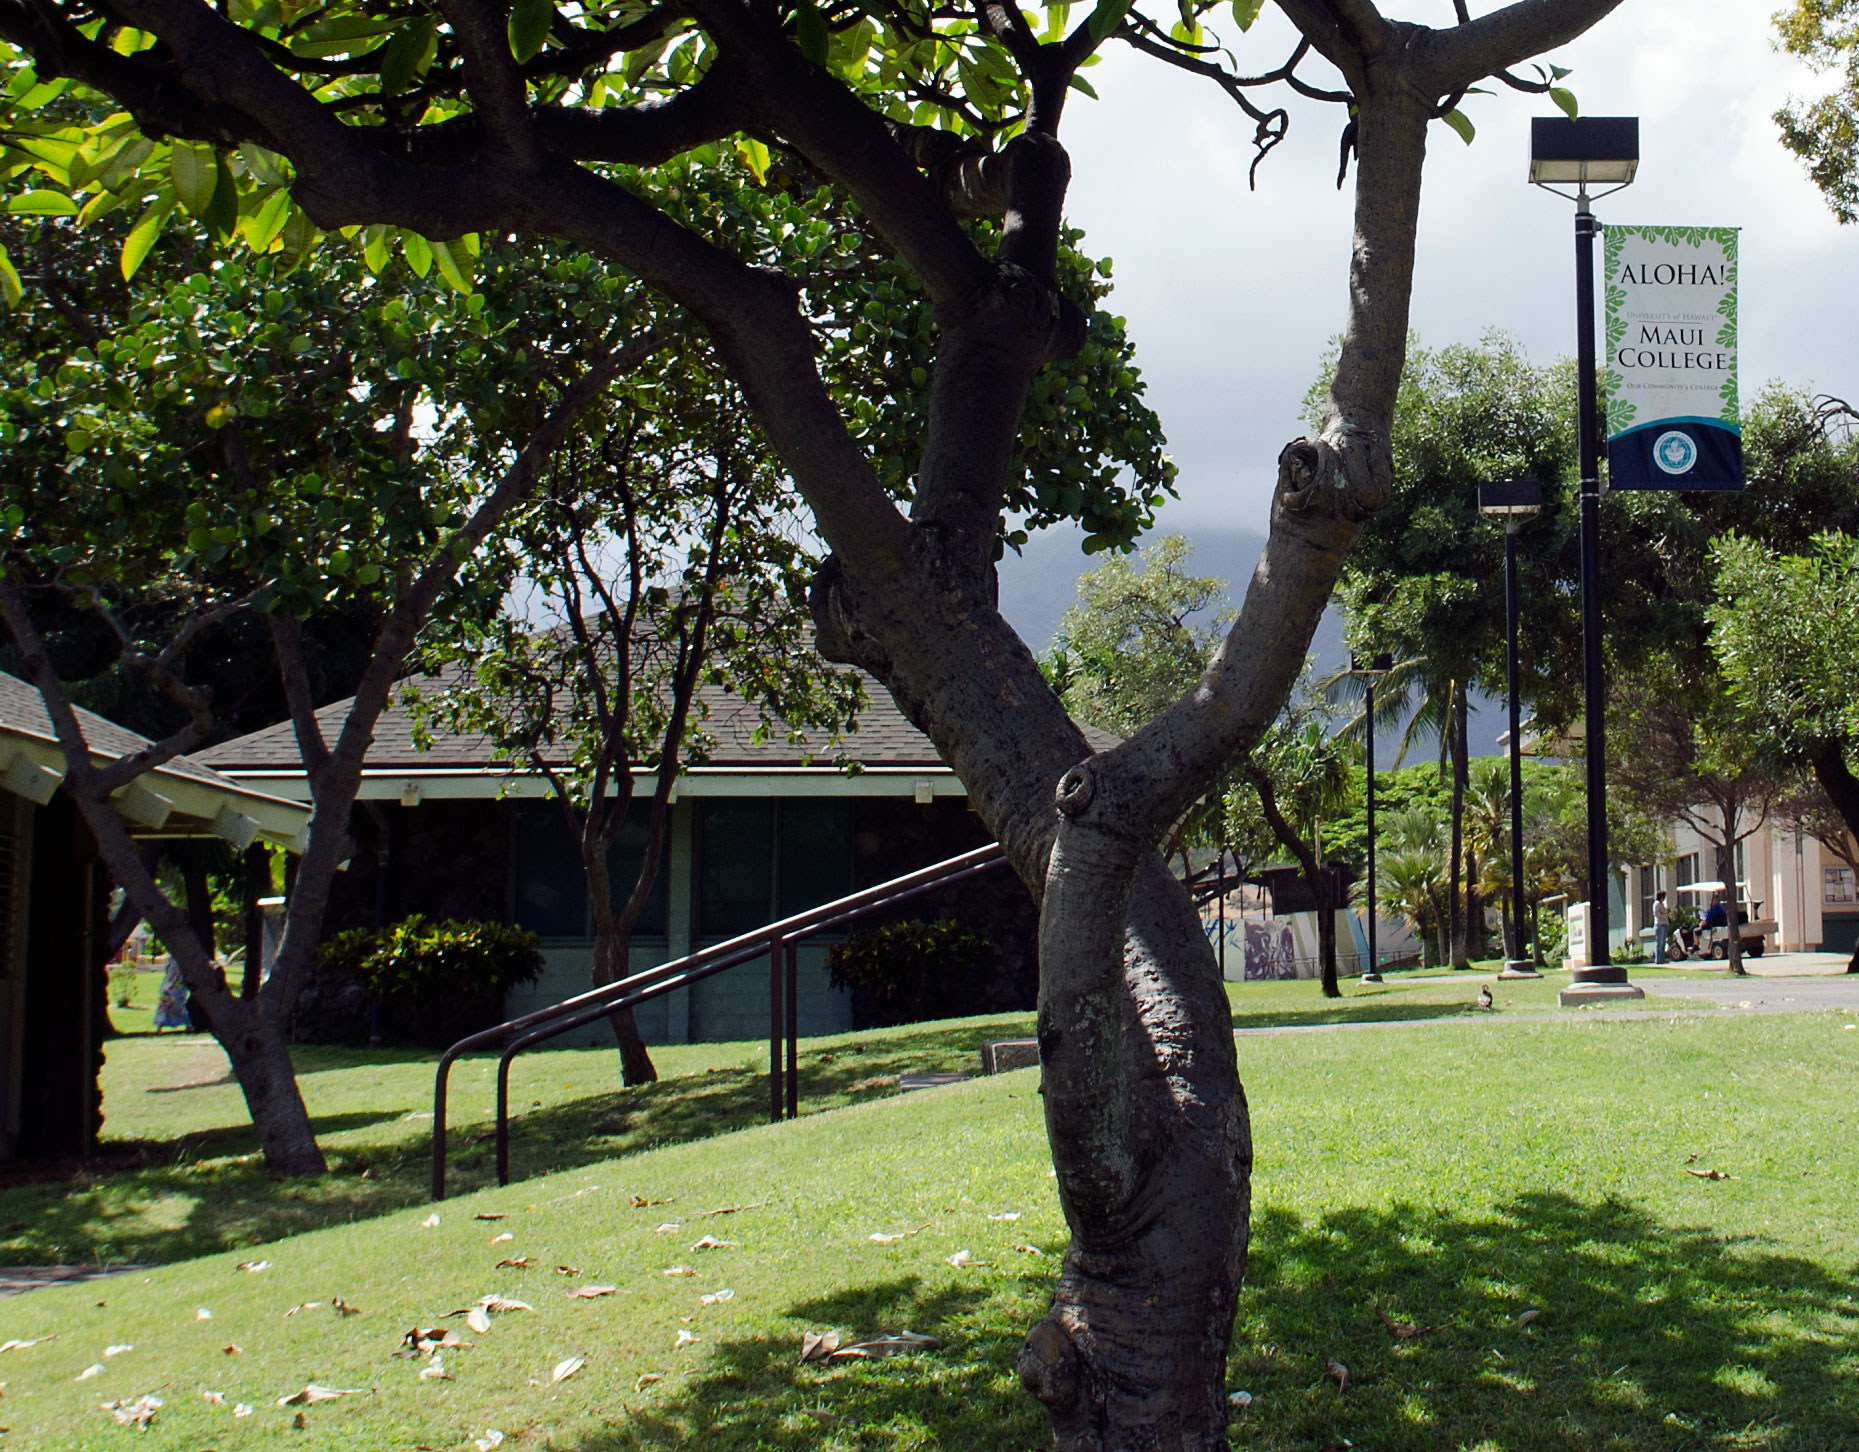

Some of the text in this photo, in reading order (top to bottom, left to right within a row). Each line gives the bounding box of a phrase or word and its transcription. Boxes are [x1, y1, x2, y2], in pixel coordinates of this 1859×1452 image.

[1620, 263, 1725, 286] ALOHA!
[1626, 311, 1671, 320] UNIVERSITY
[1640, 324, 1704, 346] MAUI
[1618, 347, 1728, 370] COLLEGE
